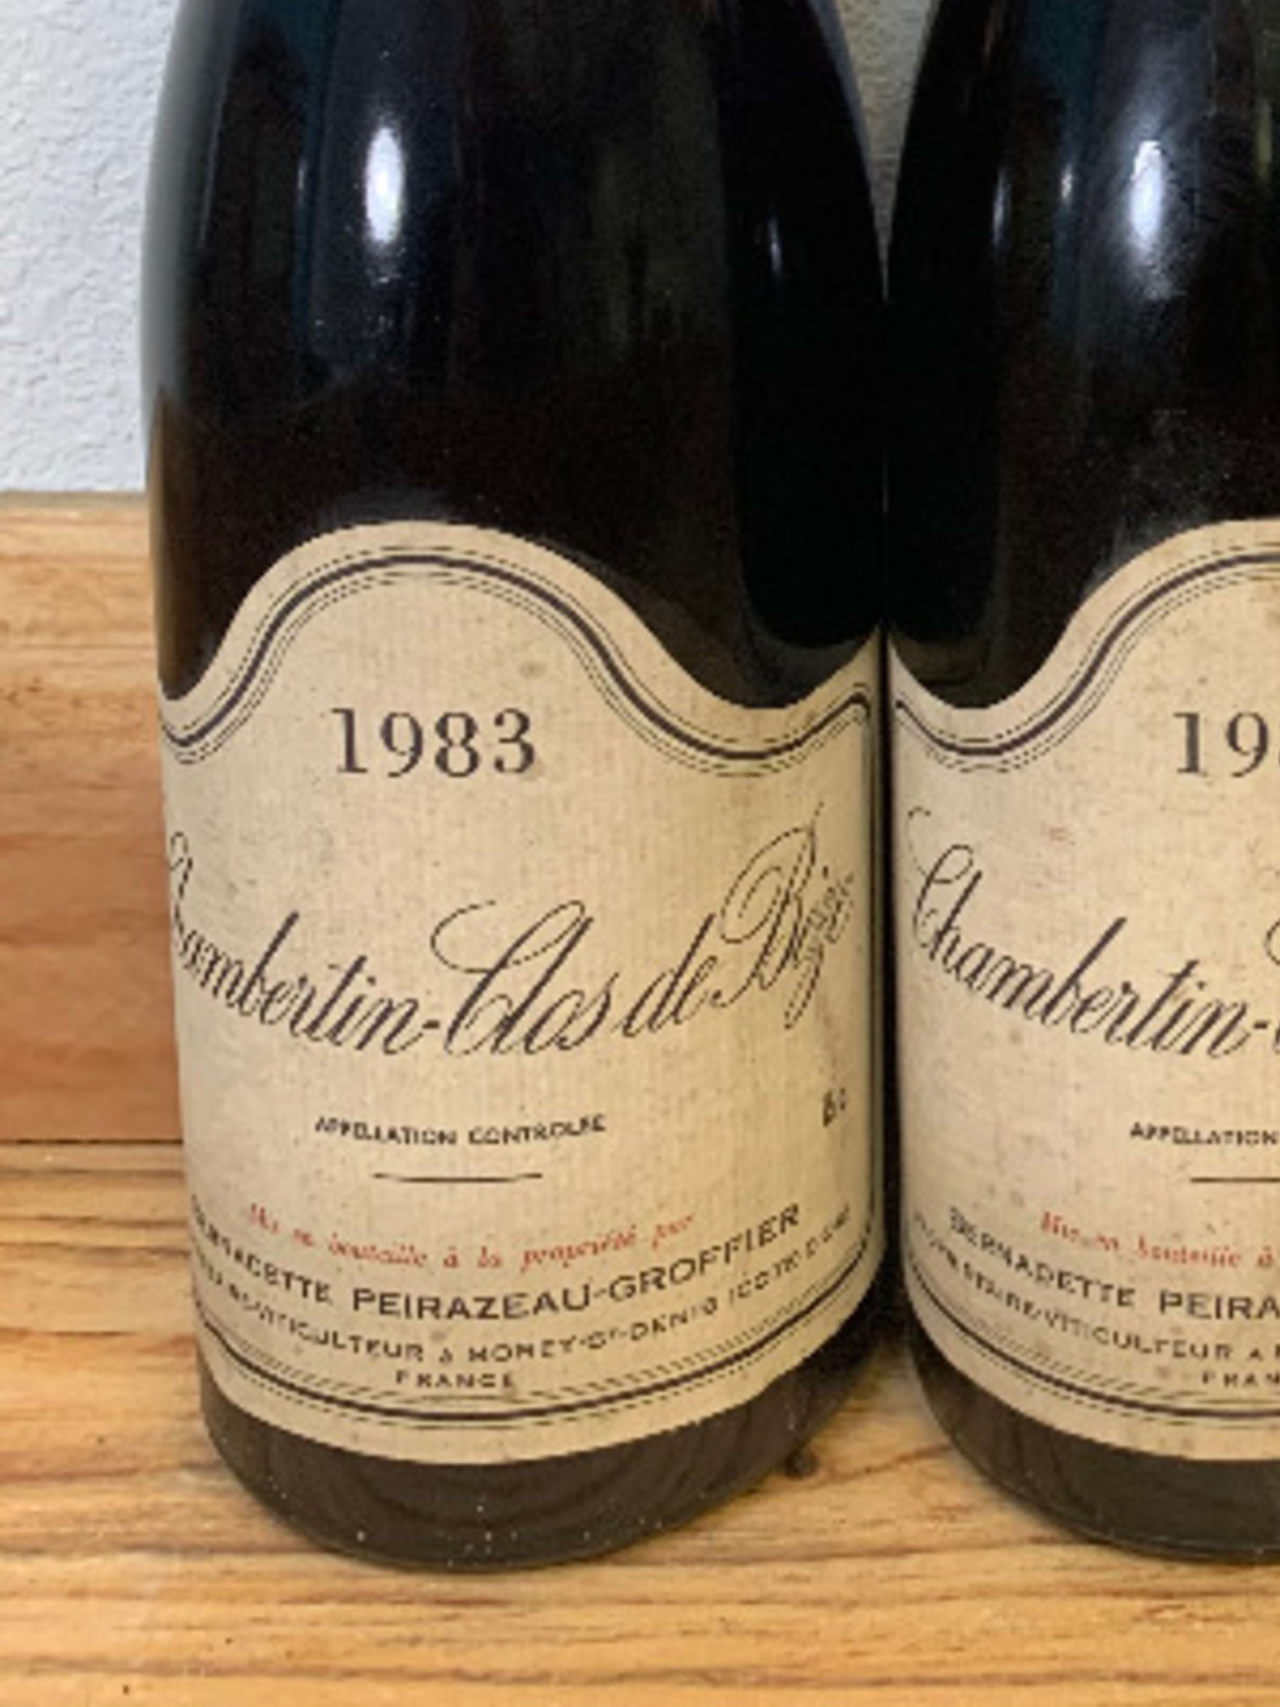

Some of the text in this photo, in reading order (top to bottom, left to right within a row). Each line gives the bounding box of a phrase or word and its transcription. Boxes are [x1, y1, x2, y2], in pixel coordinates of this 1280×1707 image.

[330, 707, 537, 778] 1983
[611, 912, 712, 1038] de
[314, 1115, 457, 1146] APPELLATION
[1129, 1121, 1280, 1145] APPELLATION
[352, 1202, 800, 1321] PEIRAZEAU-GROFFIER
[476, 1245, 502, 1268] la
[394, 1369, 515, 1389] FRANCE
